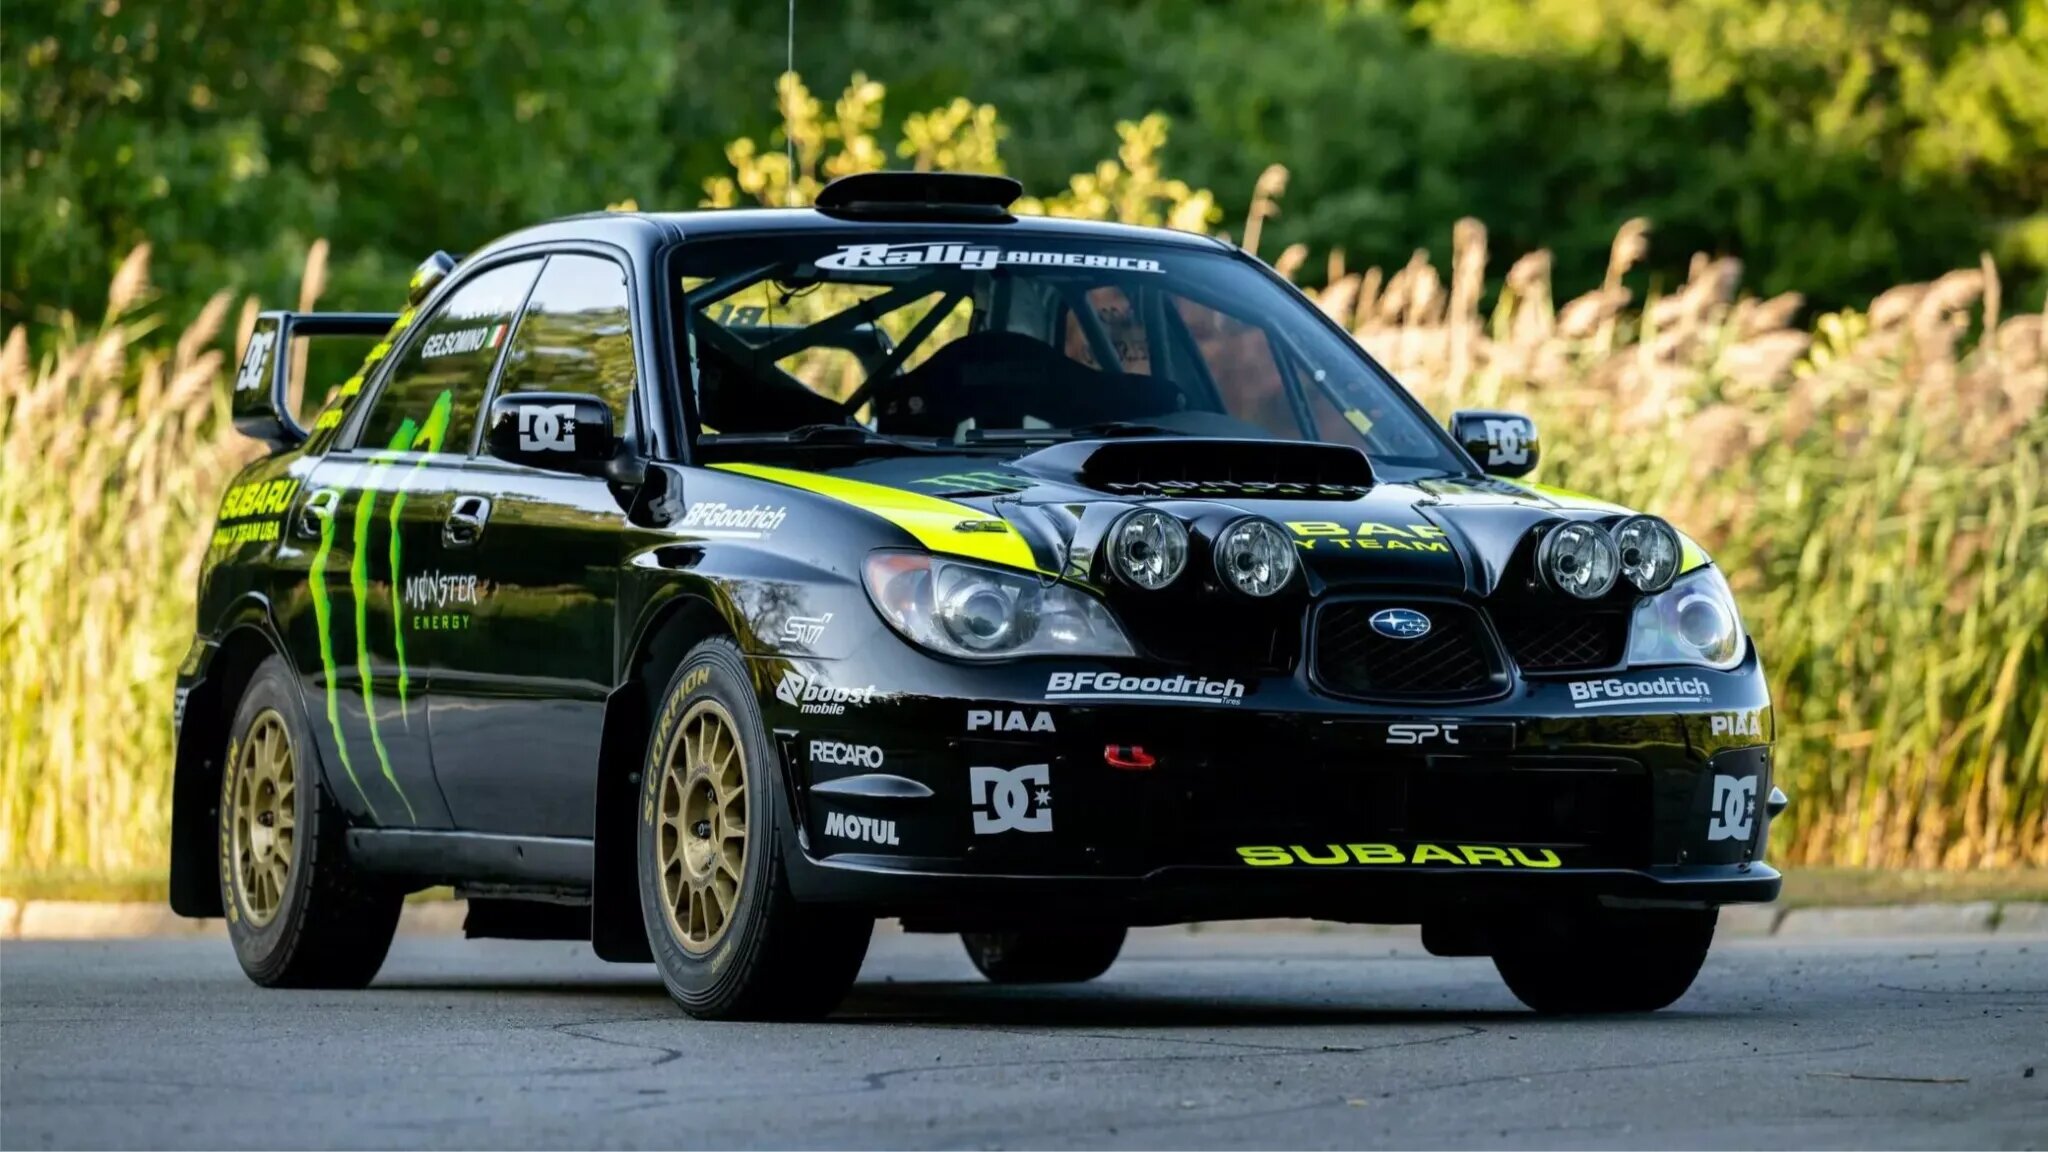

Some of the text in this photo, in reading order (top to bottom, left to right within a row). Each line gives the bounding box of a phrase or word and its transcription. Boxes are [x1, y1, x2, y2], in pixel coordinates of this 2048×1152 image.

[814, 241, 1166, 273] Rally AMERICA
[422, 327, 488, 358] GELSOMINO
[519, 404, 576, 452] DC
[1483, 419, 1528, 465] DC
[220, 479, 299, 519] SUBARU
[681, 502, 787, 529] BFGoodrich
[1329, 539, 1449, 552] TEAM
[414, 615, 470, 630] ENERGY
[802, 673, 876, 704] boost
[1047, 672, 1245, 697] BFGoodrich
[1568, 677, 1711, 700] BFGoodrich
[801, 703, 845, 715] mobile
[967, 710, 1056, 733] PIAA
[1711, 716, 1761, 736] PIAA
[644, 667, 711, 826] SCORPION
[809, 740, 884, 769] RECARO
[969, 763, 1053, 835] DC
[1707, 774, 1758, 841] DC
[824, 812, 900, 846] MOTUL
[1236, 843, 1562, 869] SUBARU
